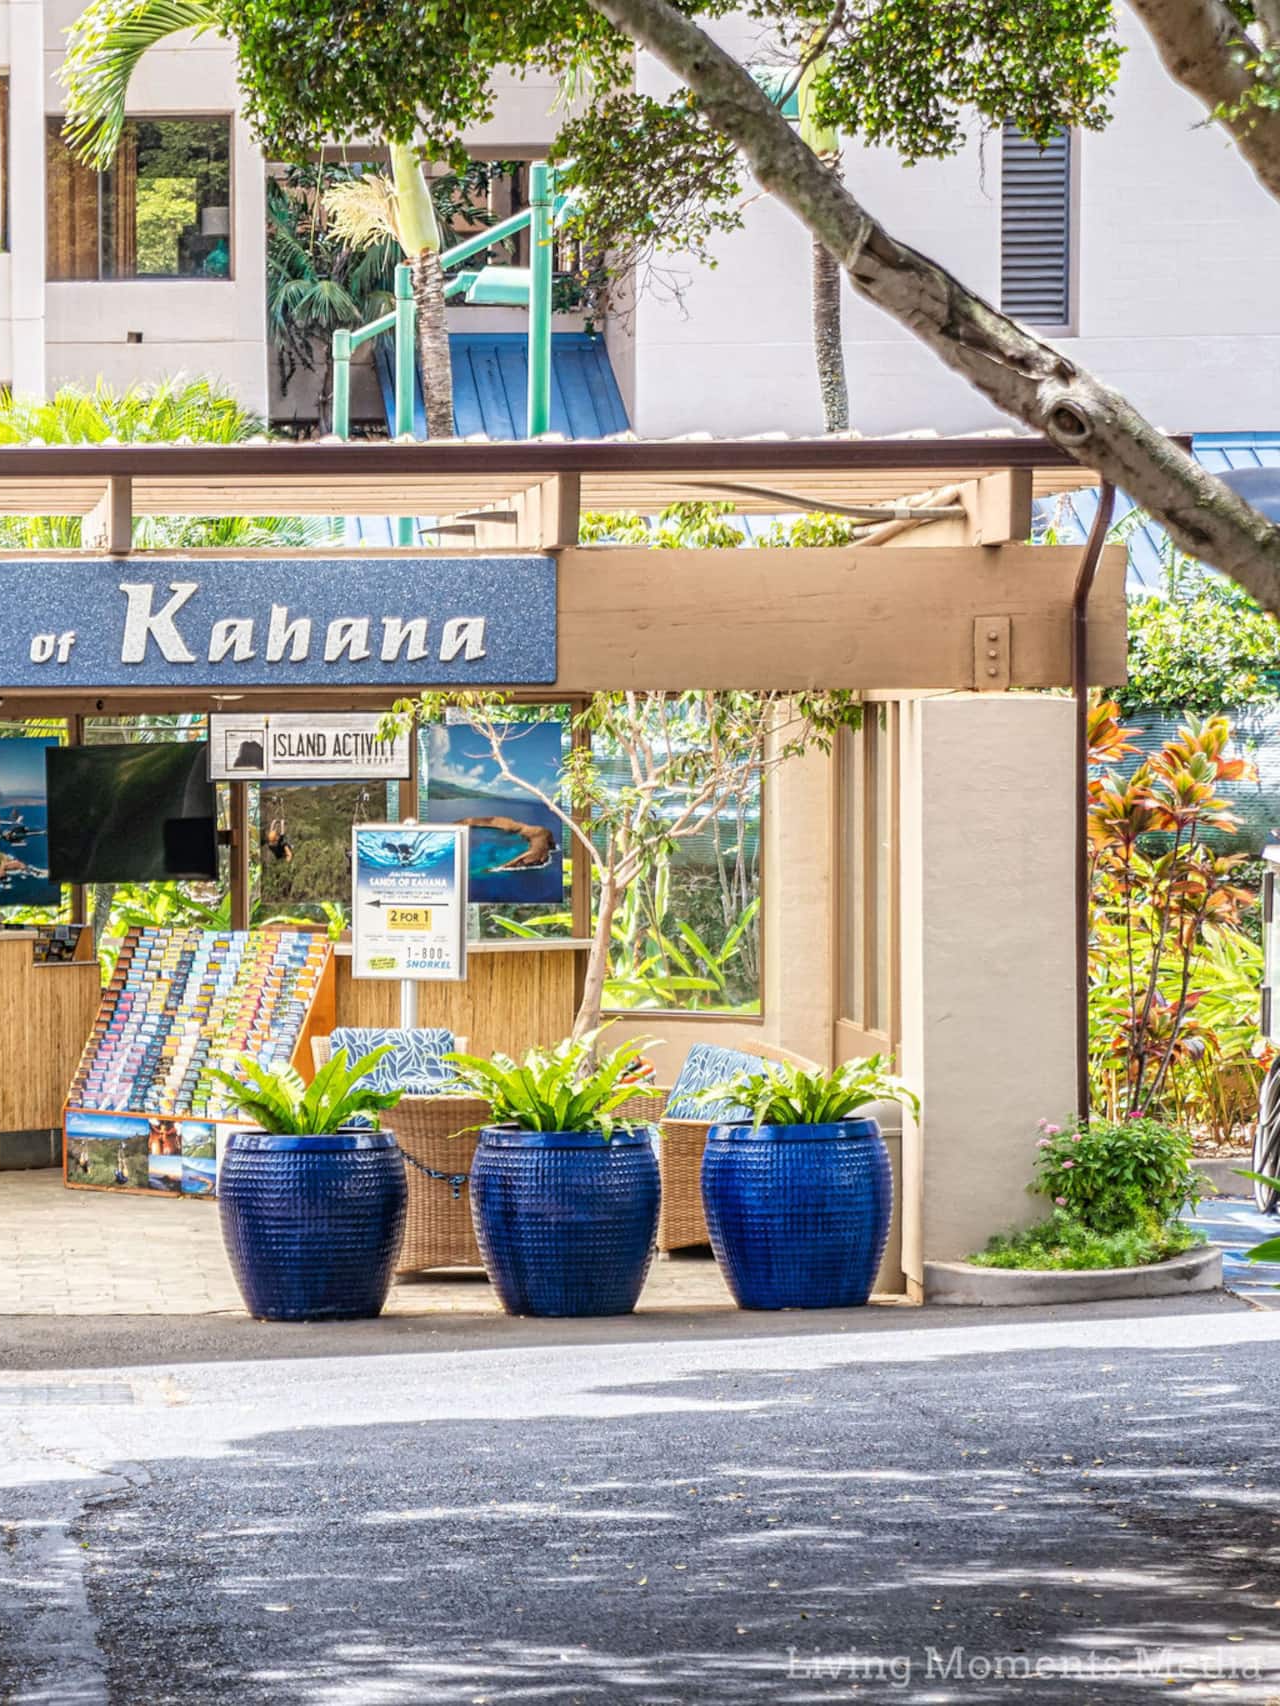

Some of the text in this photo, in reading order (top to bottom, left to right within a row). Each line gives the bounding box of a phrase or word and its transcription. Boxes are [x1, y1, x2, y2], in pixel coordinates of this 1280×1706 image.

[30, 631, 76, 664] of
[119, 583, 487, 664] Kahana
[273, 733, 327, 757] ISLAND
[369, 877, 397, 887] SANDS
[398, 878, 411, 887] OF
[390, 910, 429, 922] 2 FOR 1
[406, 960, 451, 969] SNORKEL
